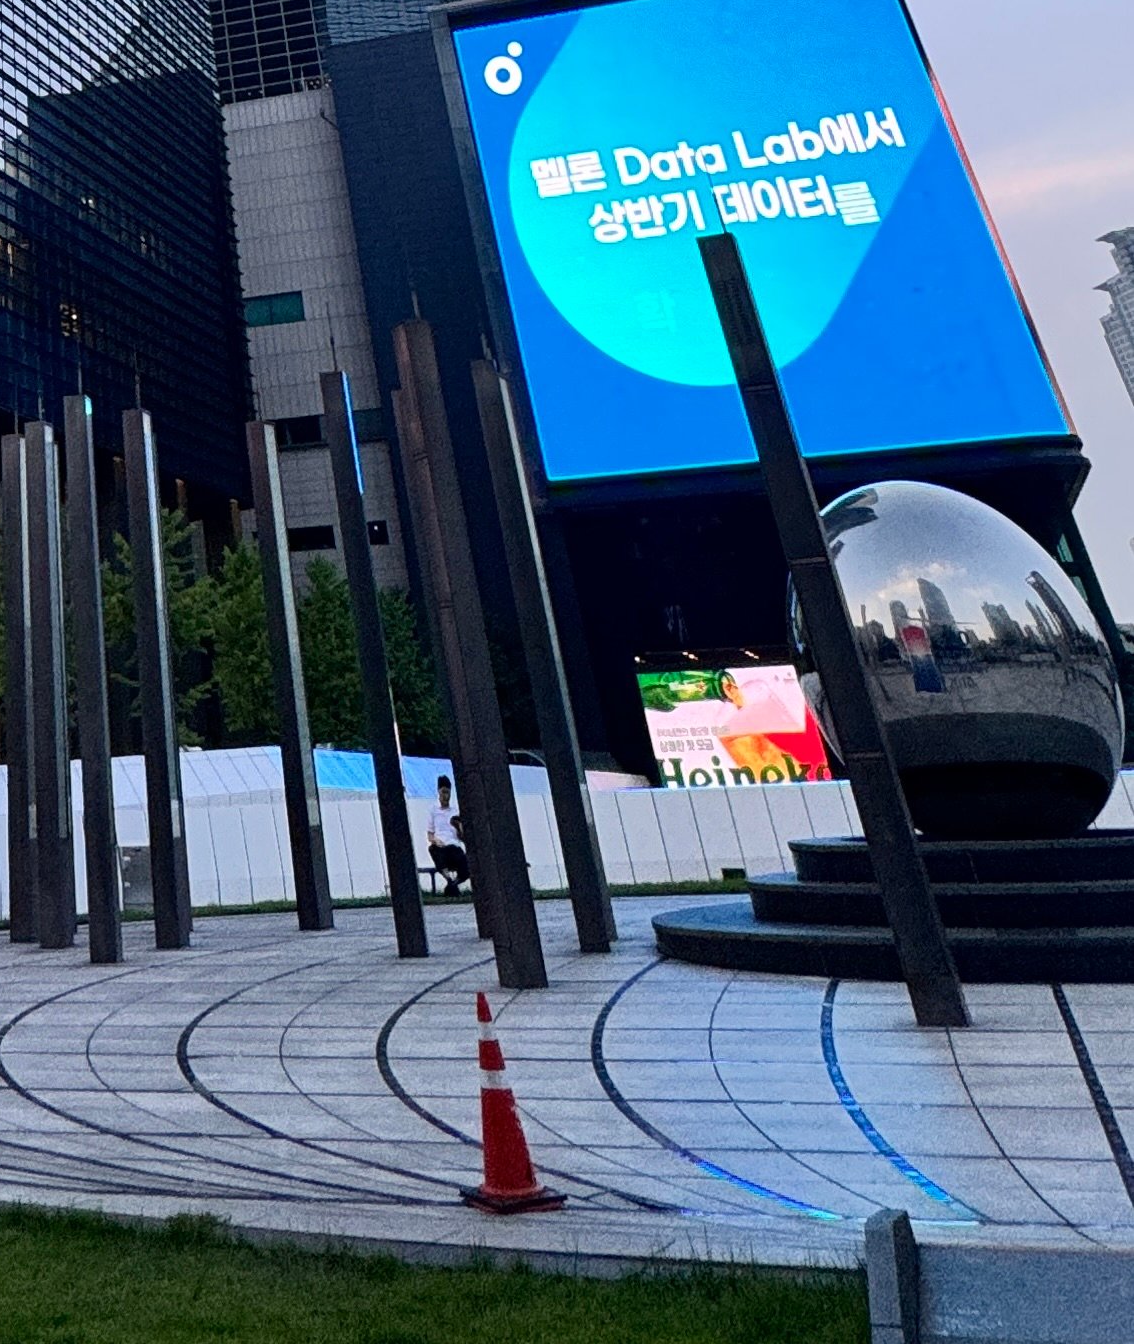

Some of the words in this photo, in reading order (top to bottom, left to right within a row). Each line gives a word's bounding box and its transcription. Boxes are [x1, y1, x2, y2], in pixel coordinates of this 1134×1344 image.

[529, 150, 608, 199] 멜론
[613, 140, 728, 187] Data
[731, 107, 907, 169] Lab에서
[588, 189, 706, 244] 상반기
[712, 174, 881, 227] 데이터를
